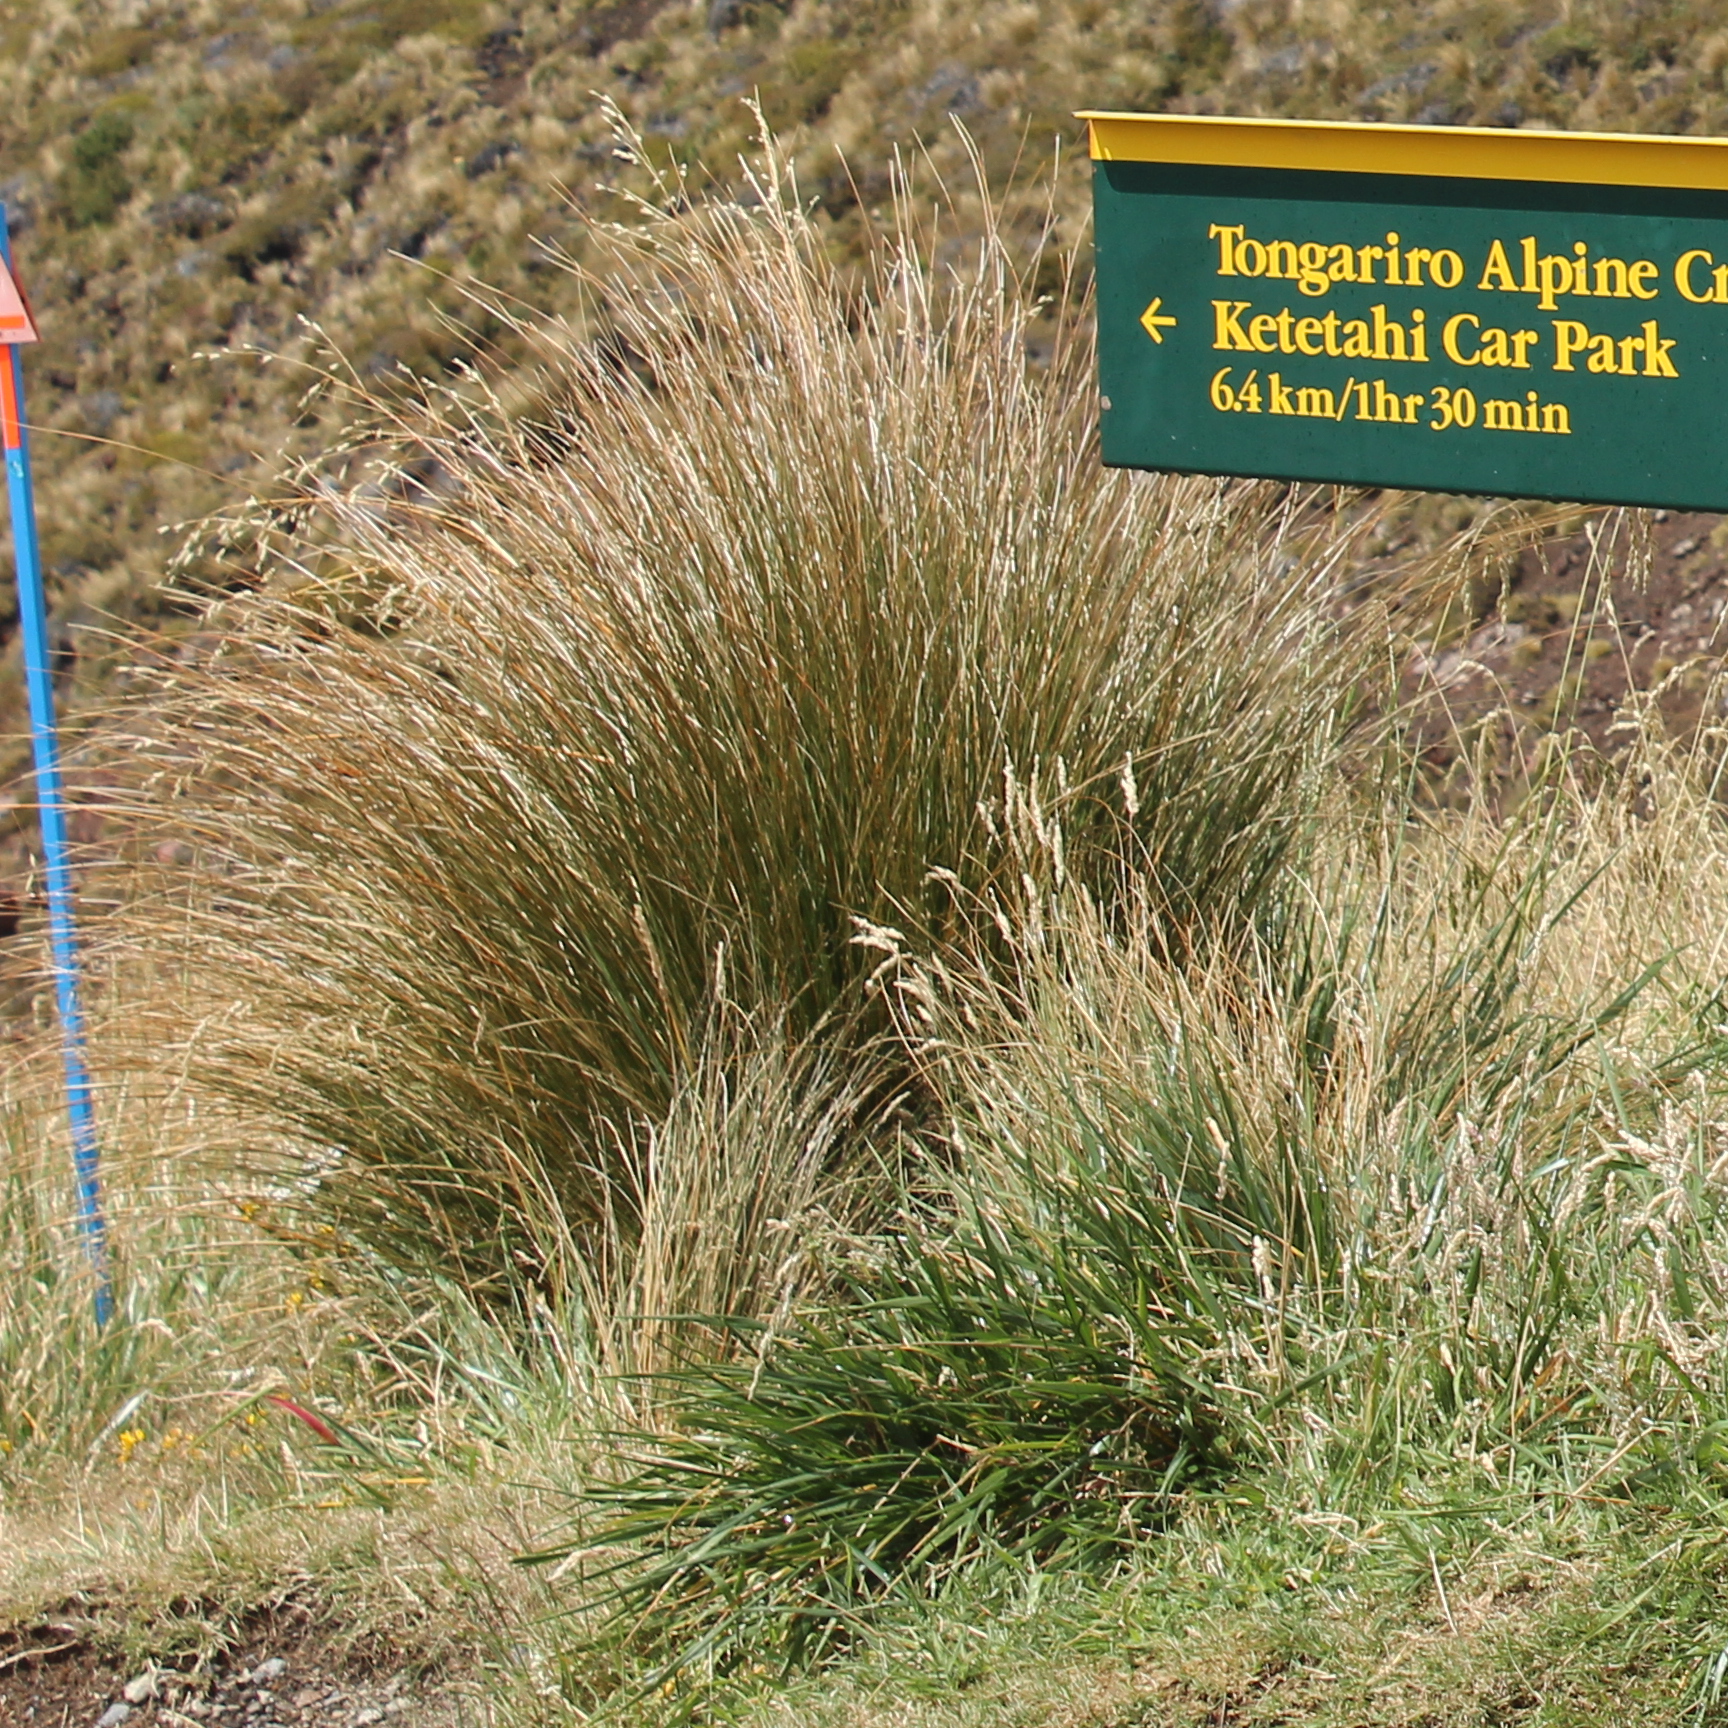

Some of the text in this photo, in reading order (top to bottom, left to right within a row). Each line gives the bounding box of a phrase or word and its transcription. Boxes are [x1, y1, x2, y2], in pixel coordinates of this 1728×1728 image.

[1207, 223, 1466, 297] Tongariro
[1477, 235, 1660, 312] Alpine
[1210, 299, 1680, 379] Ketetahi Car Park
